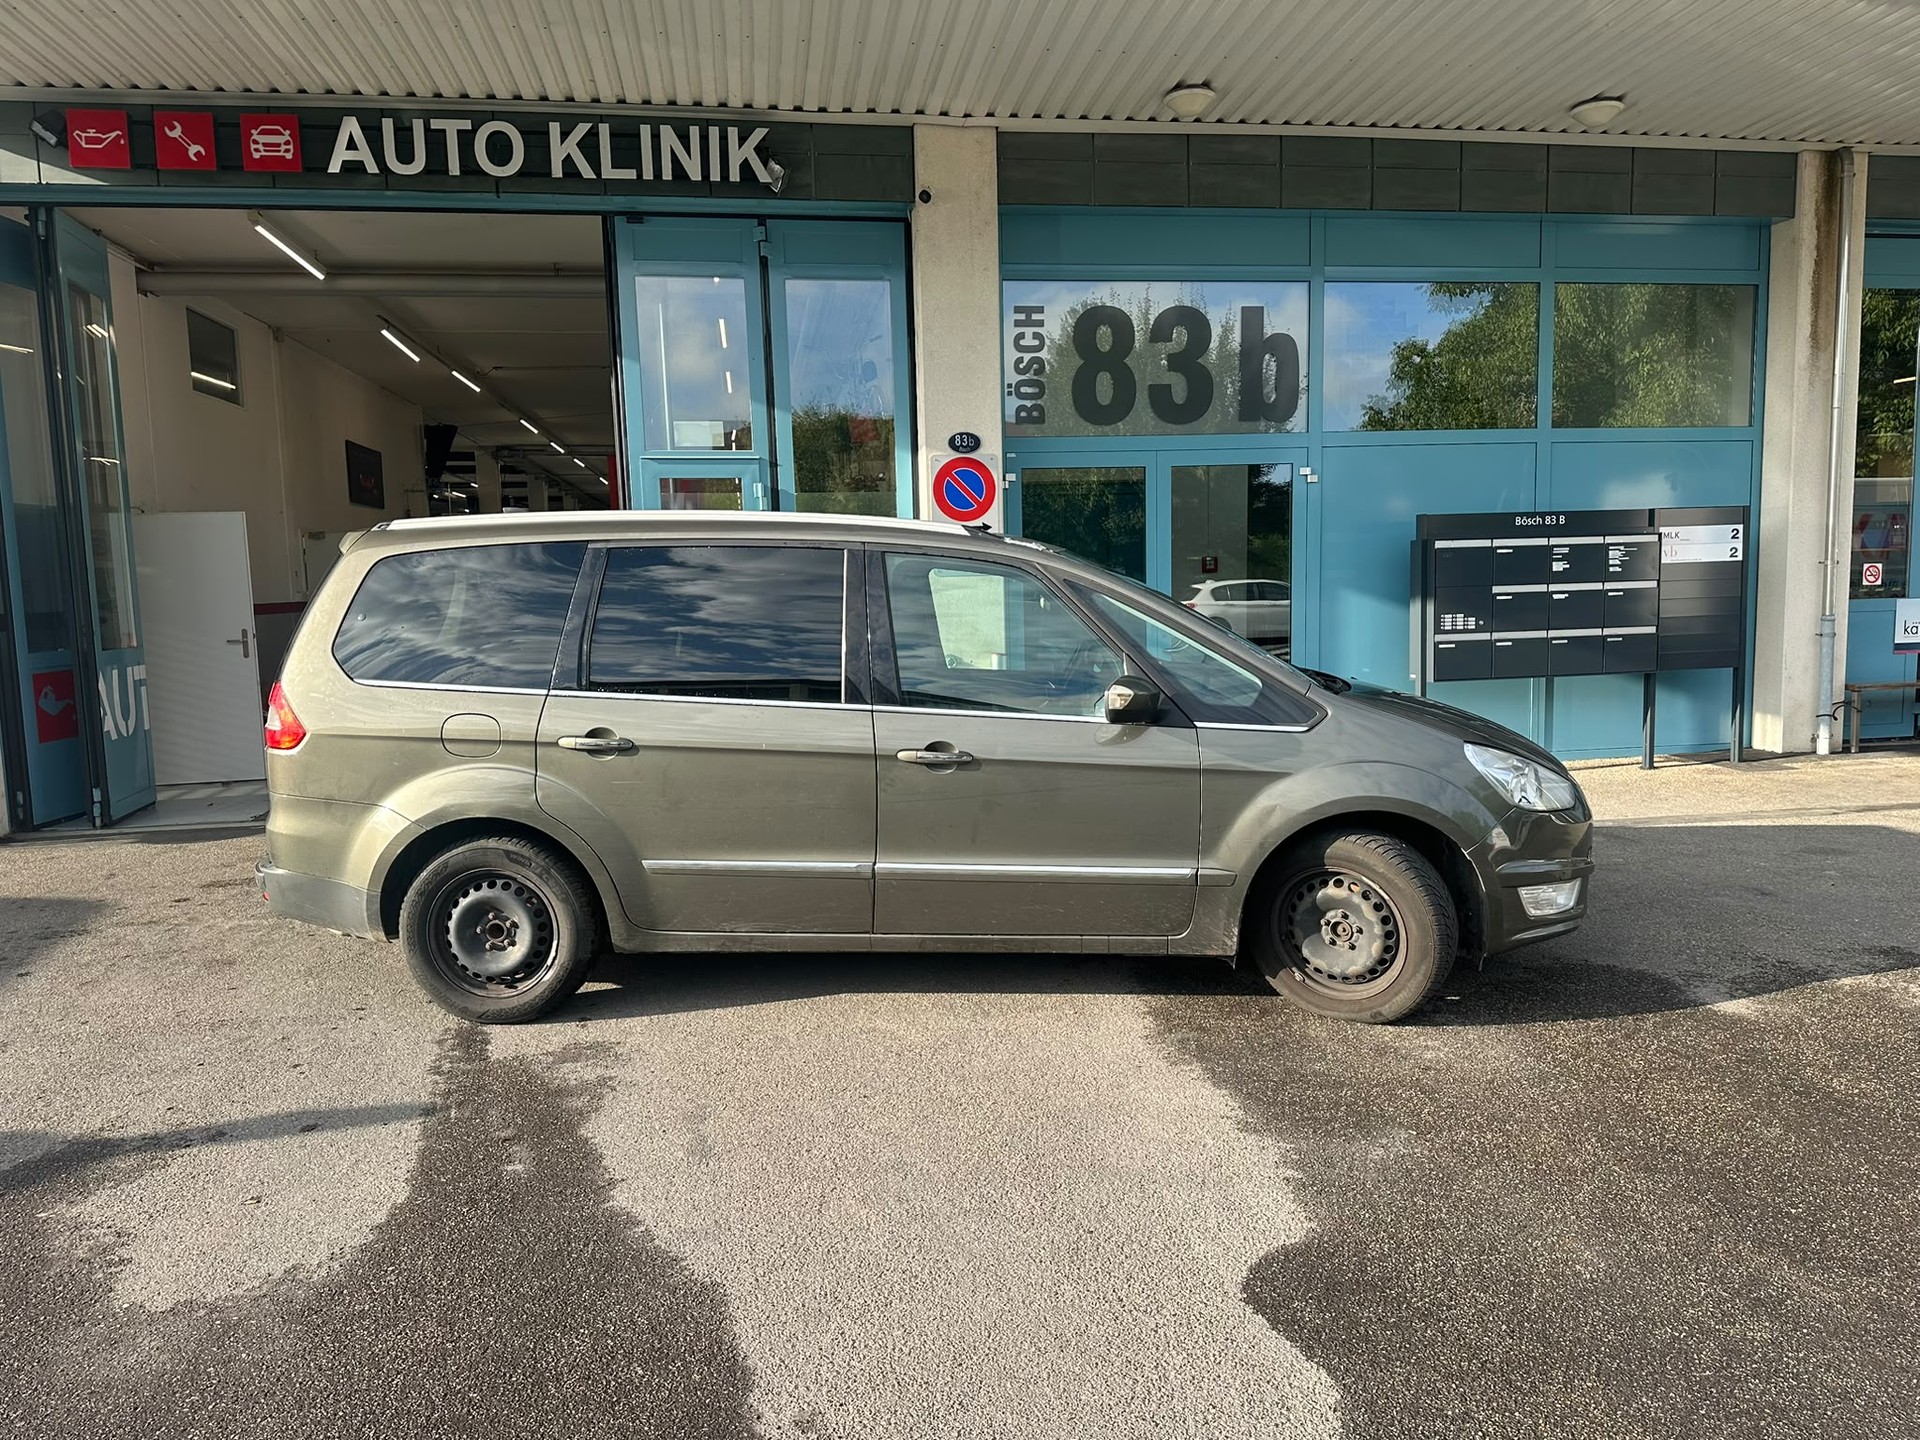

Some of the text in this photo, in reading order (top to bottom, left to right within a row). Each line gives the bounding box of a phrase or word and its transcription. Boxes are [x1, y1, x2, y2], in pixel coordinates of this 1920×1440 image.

[327, 114, 772, 184] AUTO KLINIK
[1006, 304, 1046, 426] BÖSCH
[1070, 304, 1301, 427] 83 b
[954, 434, 975, 447] 83b
[1515, 514, 1566, 526] Bösch 83 B
[1663, 528, 1740, 540] MLK 2
[1729, 546, 1739, 558] 2
